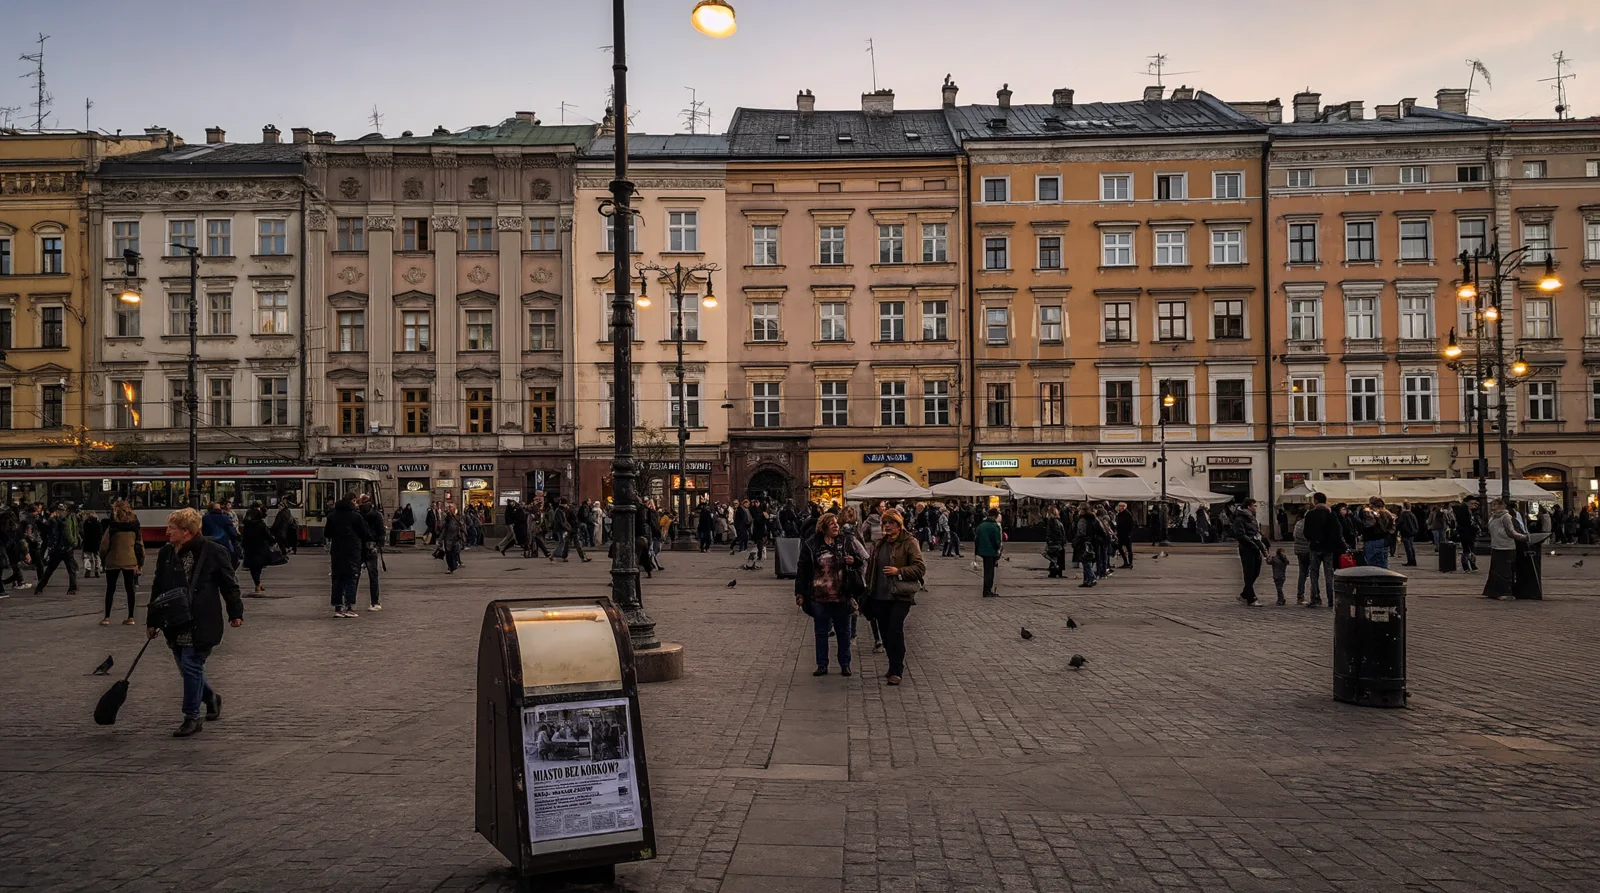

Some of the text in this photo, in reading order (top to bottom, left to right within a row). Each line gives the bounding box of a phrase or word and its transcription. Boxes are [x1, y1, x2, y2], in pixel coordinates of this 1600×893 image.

[533, 761, 619, 782] MIASTO BEZ KORKÓW?
